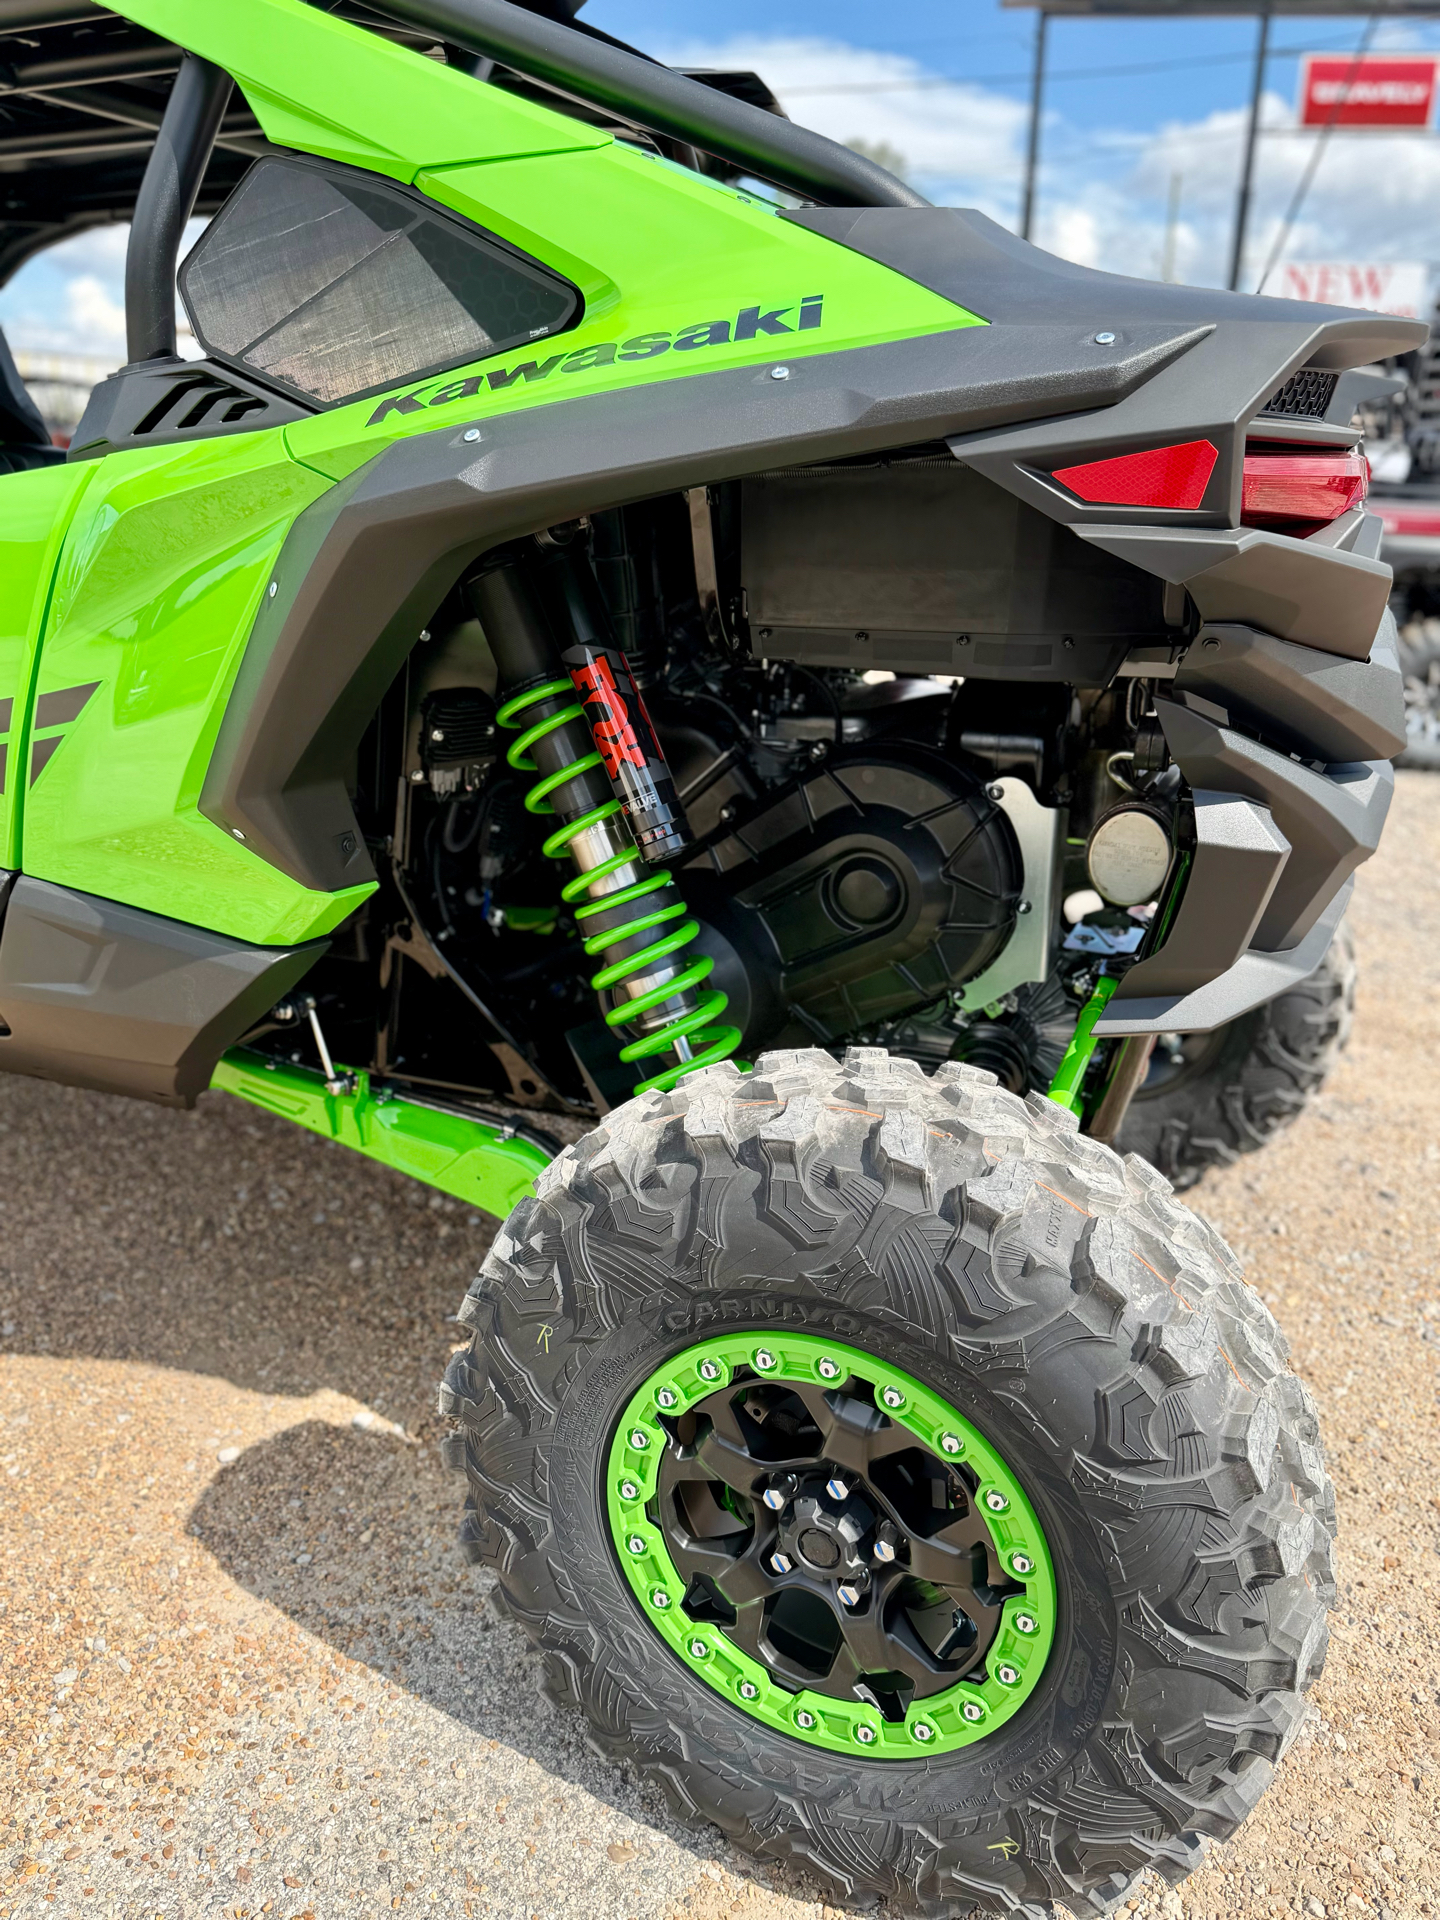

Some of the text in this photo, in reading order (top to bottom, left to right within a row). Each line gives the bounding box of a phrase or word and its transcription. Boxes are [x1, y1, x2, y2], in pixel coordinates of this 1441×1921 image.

[1283, 264, 1393, 302] NEW
[365, 294, 824, 427] Kawasaki
[570, 656, 646, 779] FOX
[537, 1323, 554, 1354] R
[664, 1298, 923, 1362] CARNIVORE
